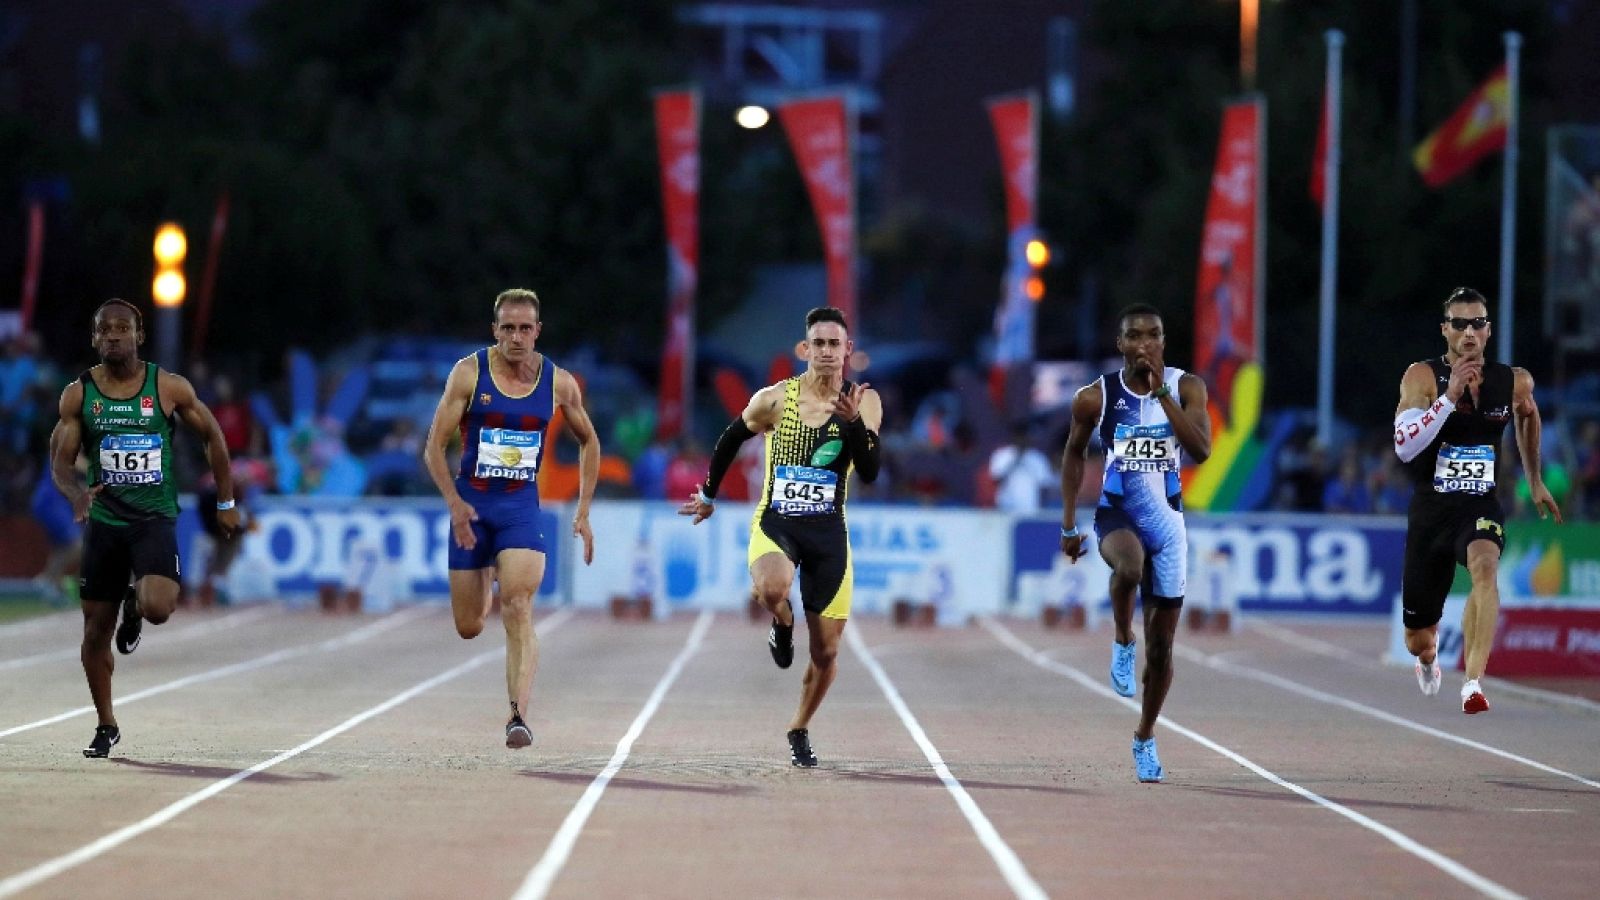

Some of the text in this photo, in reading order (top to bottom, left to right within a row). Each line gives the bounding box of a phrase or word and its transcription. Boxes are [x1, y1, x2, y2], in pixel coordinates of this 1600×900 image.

[1124, 440, 1167, 458] 445
[111, 452, 149, 471] 161
[1446, 461, 1486, 479] 553
[784, 482, 824, 502] 645
